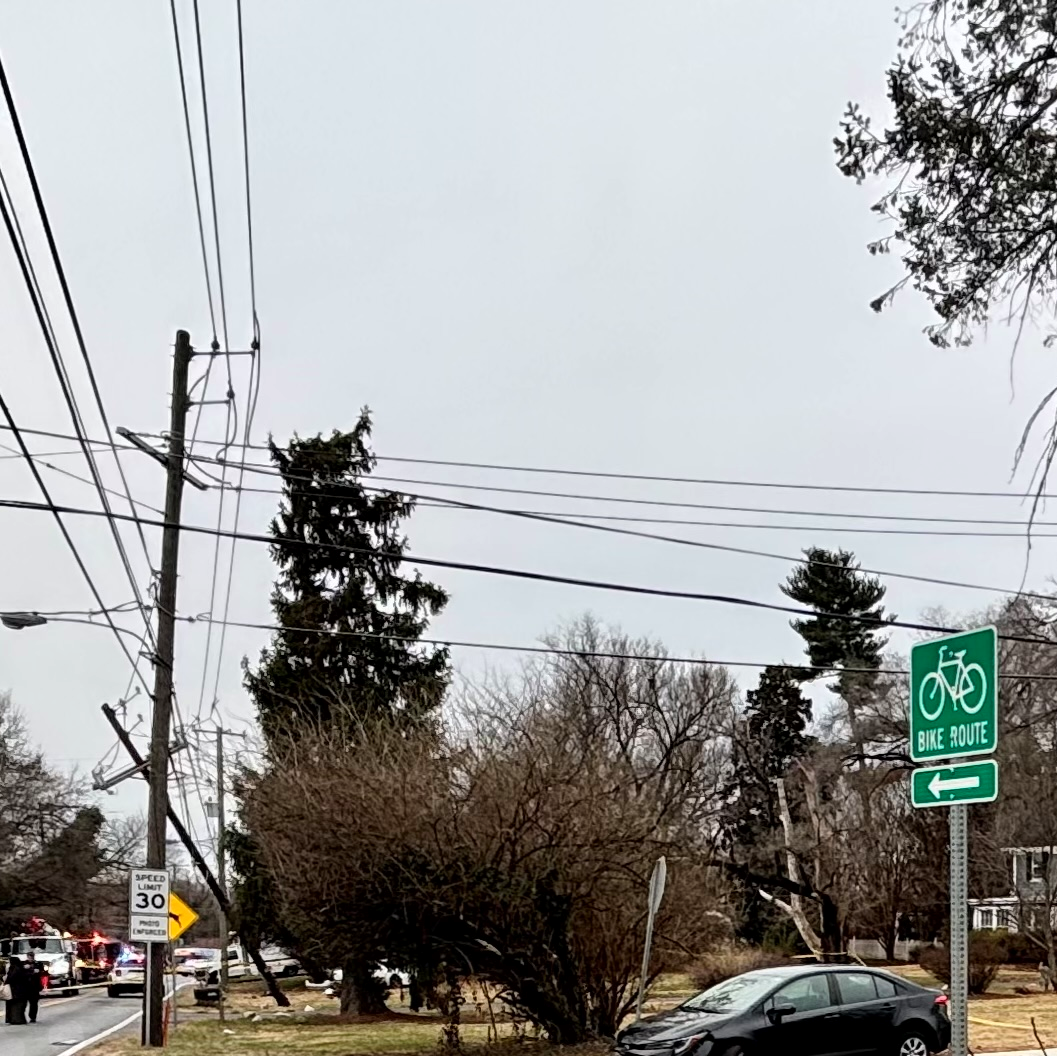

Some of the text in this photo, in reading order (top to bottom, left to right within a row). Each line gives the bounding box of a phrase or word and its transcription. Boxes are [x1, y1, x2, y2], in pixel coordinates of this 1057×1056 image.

[917, 721, 988, 752] BIKE ROUTE
[135, 874, 166, 882] SPEED
[137, 883, 163, 891] LIMIT
[135, 892, 165, 909] 30
